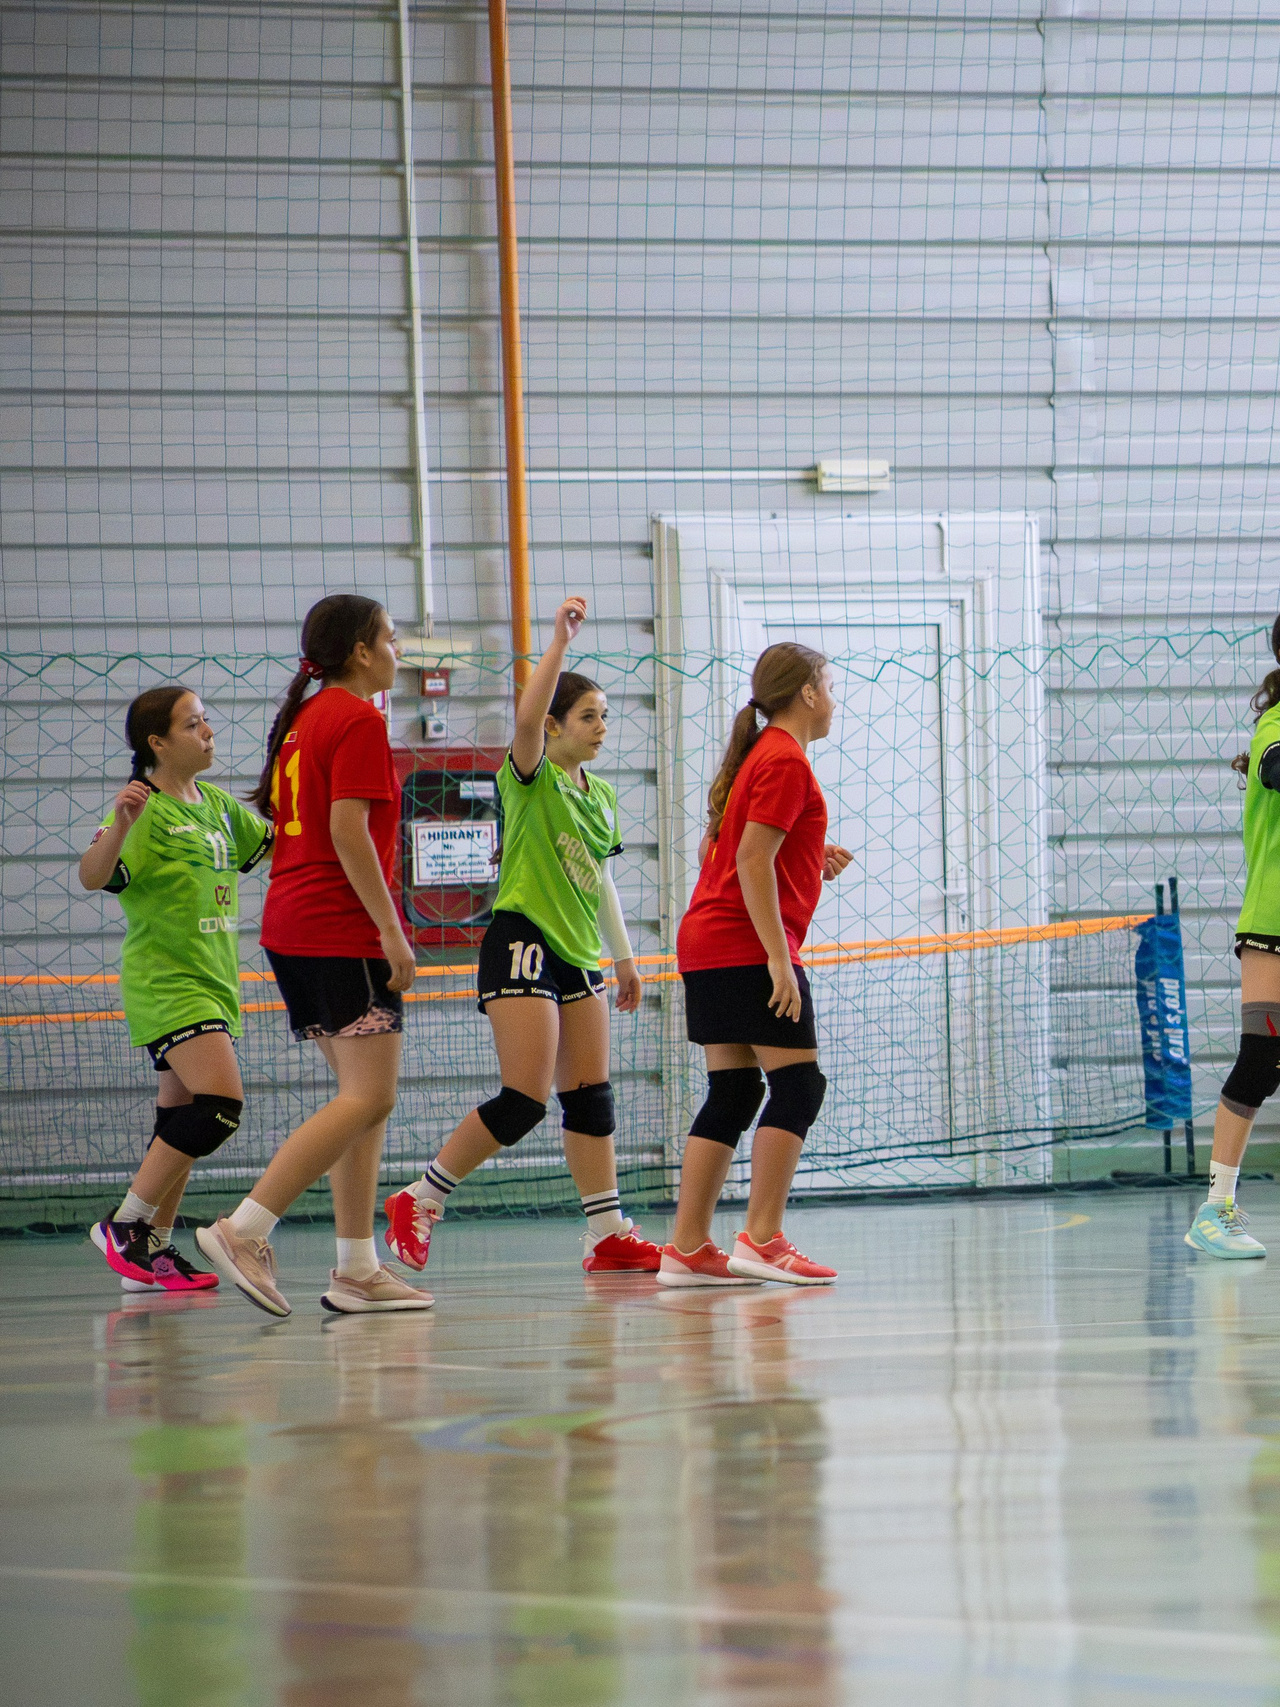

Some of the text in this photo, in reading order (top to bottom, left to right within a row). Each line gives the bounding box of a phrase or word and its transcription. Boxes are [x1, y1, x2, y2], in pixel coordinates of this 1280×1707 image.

[1245, 938, 1269, 950] Kempa
[508, 940, 545, 981] 10
[500, 987, 525, 996] Kempa
[561, 989, 587, 1001] Kempa
[171, 1028, 196, 1043] Kempa
